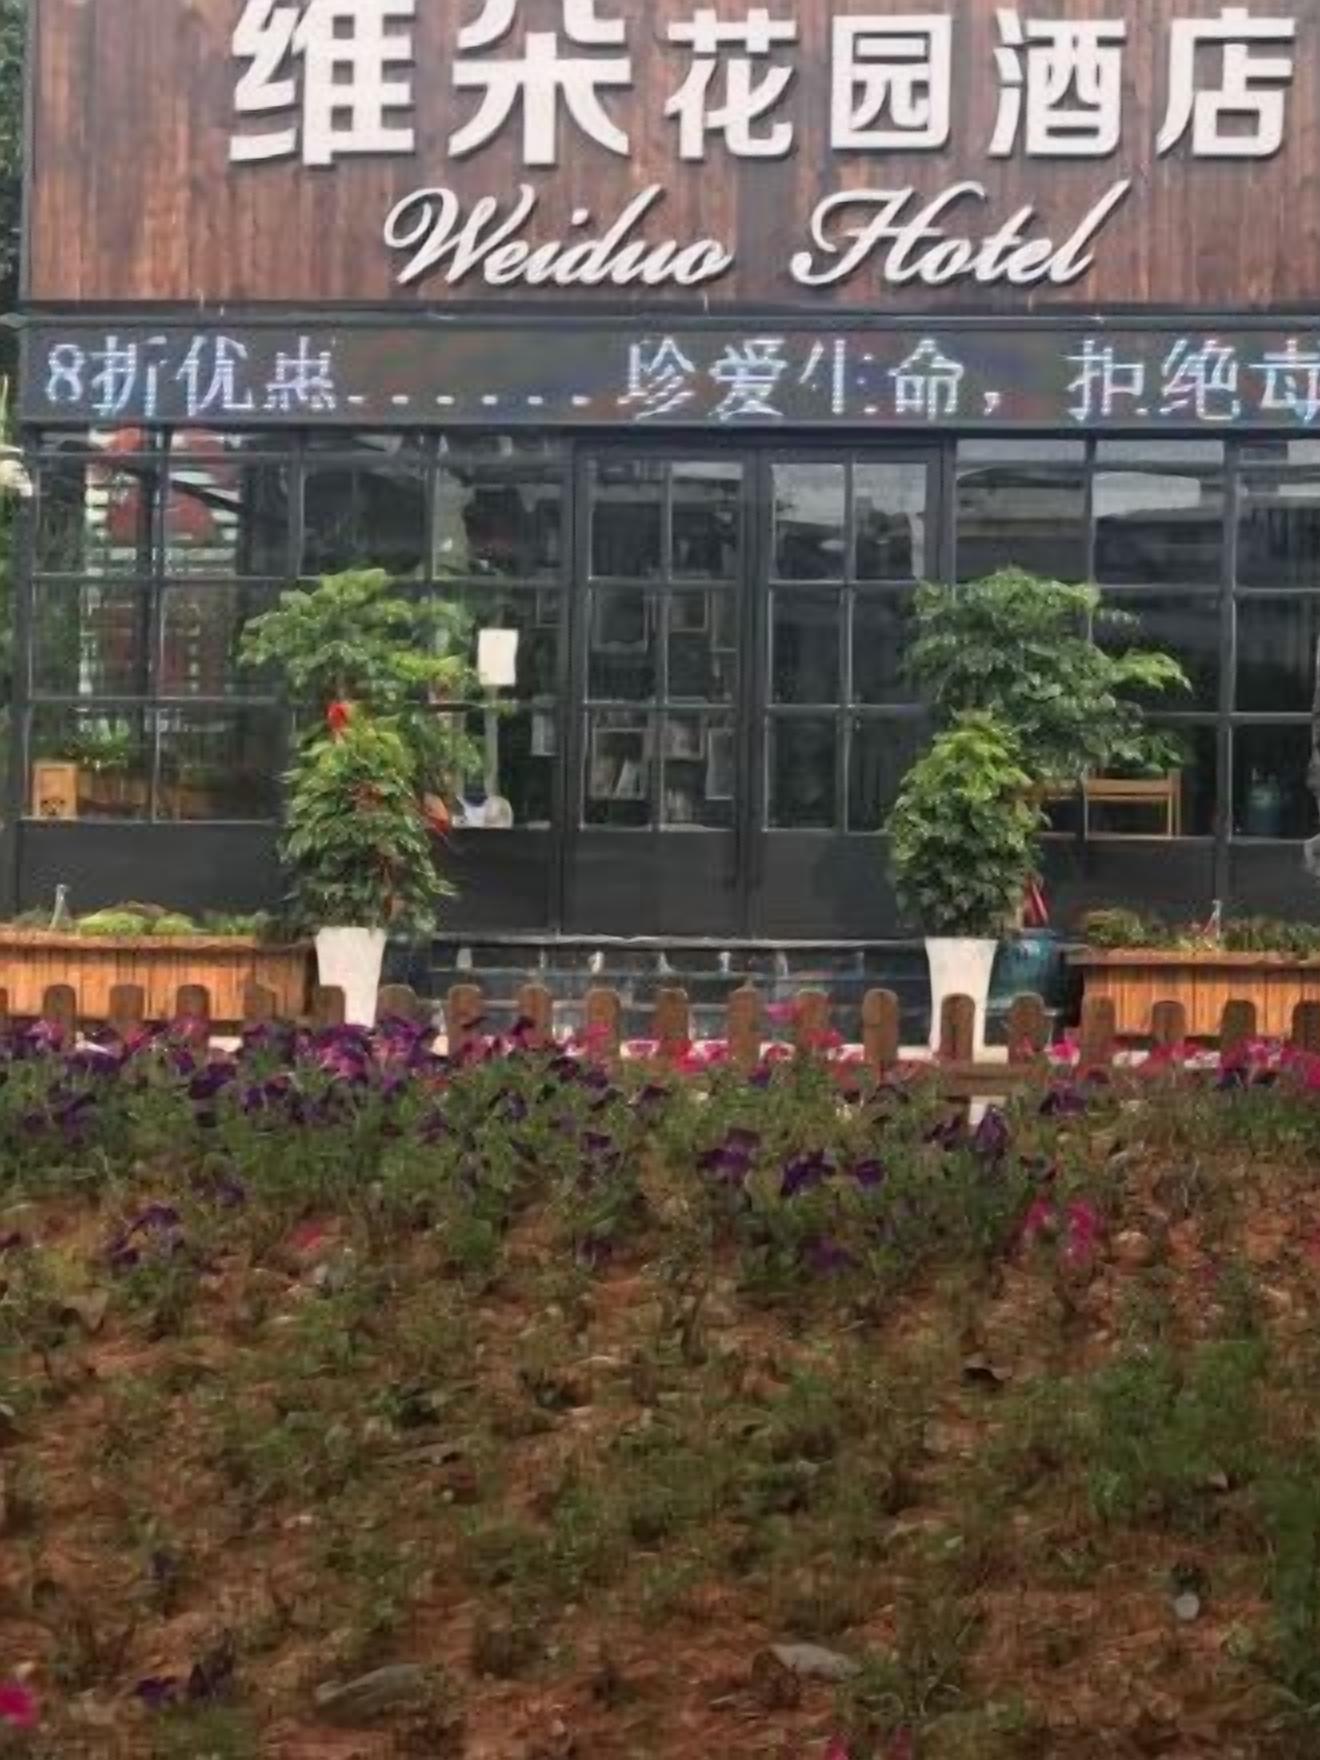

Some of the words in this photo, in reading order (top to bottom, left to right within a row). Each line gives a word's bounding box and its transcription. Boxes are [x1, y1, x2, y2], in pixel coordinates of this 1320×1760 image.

[228, 0, 1298, 166] 维朵花园酒店
[383, 184, 733, 287] Weiduo
[789, 180, 1132, 287] Hotel
